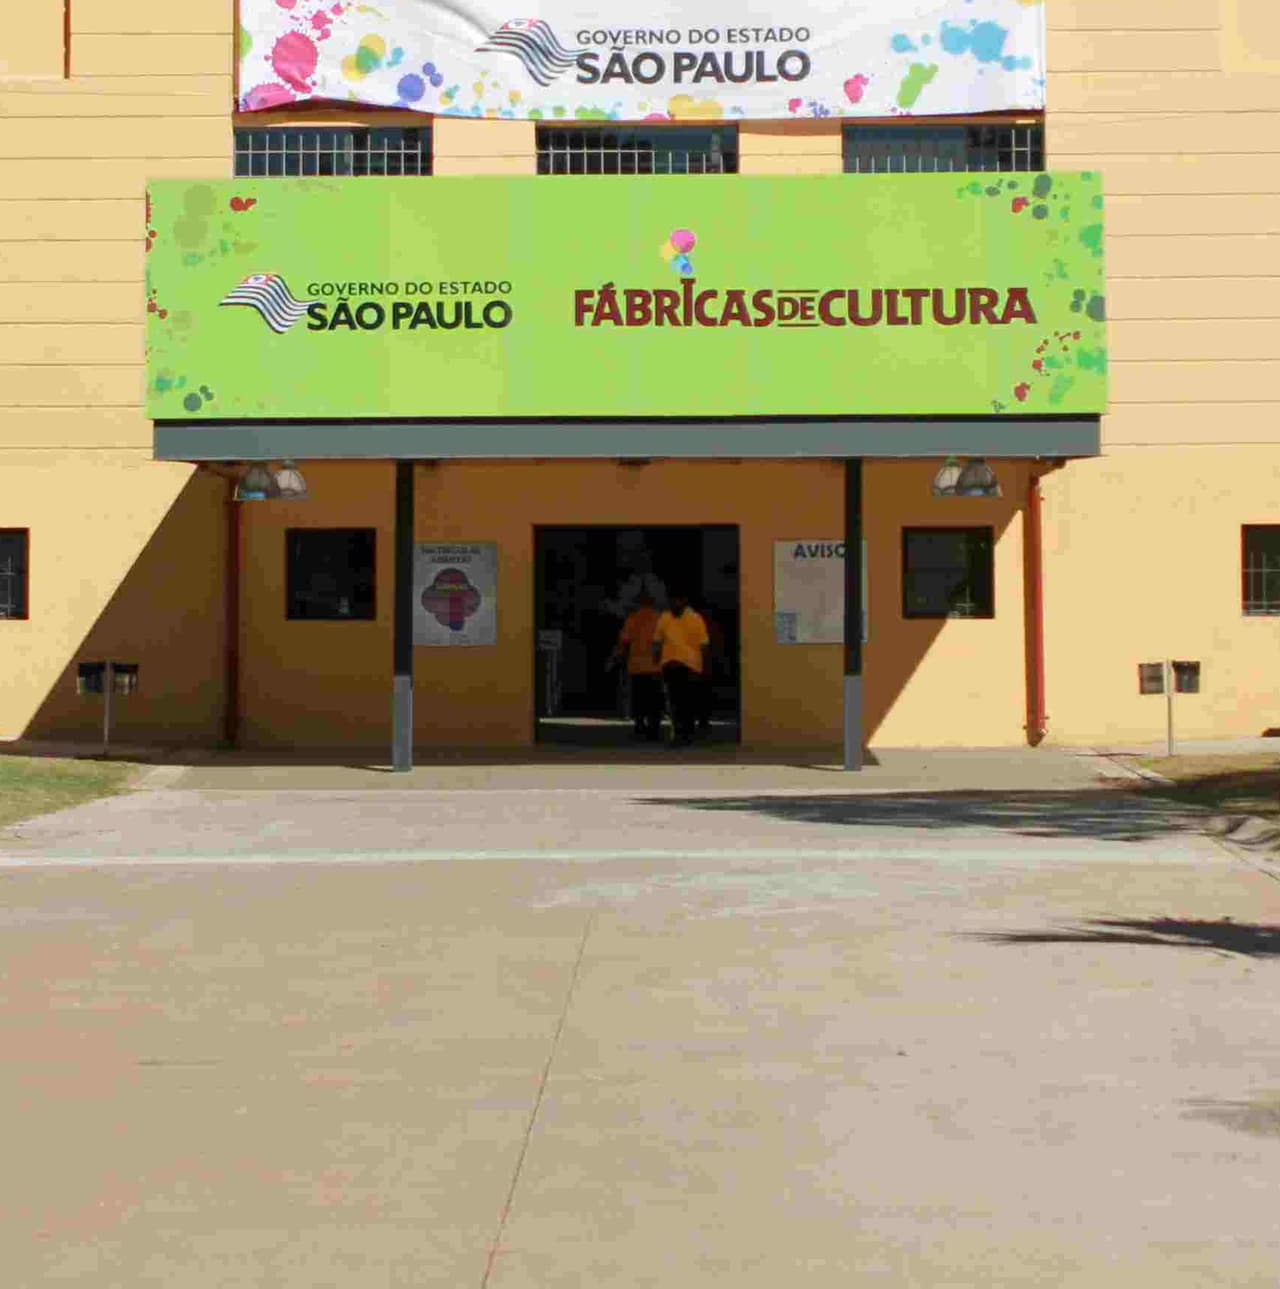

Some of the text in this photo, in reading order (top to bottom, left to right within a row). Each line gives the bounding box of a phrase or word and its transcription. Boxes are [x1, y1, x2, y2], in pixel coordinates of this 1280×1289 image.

[576, 26, 811, 45] GOVERNO DO ESTADO
[576, 46, 811, 85] SÃO PAULO
[306, 280, 512, 296] GOVERNO DO ESTADO
[306, 296, 513, 331] SÃO PAULO
